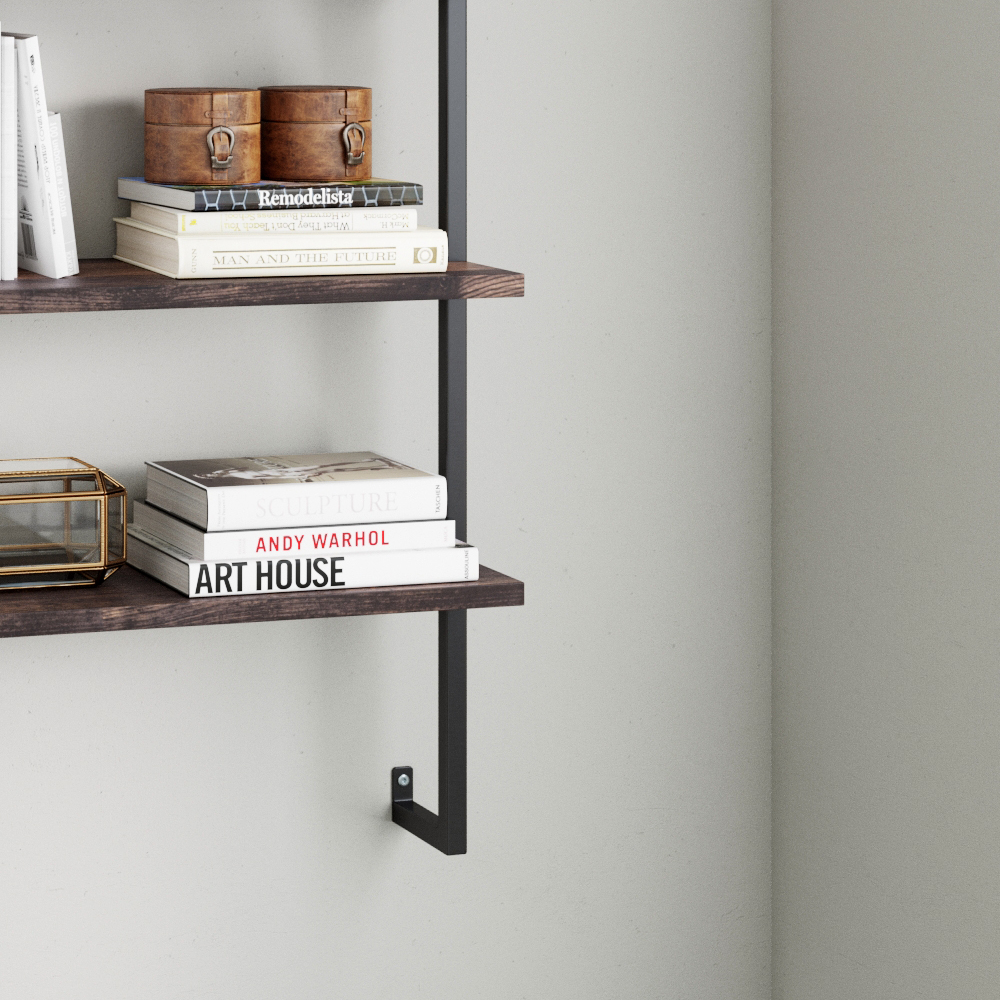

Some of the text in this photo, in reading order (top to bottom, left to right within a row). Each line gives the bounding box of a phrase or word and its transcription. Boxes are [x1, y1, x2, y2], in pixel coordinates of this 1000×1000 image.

[258, 188, 353, 206] Remodelista
[257, 212, 298, 220] Business
[301, 211, 338, 220] Harvard
[363, 212, 409, 220] McCormack
[224, 220, 350, 232] What They Don't Teach You
[389, 221, 409, 229] Mark
[213, 251, 396, 265] MAN AND THE FUTURE
[256, 491, 398, 518] SCULPTURE
[256, 535, 304, 553] ANDY
[312, 530, 389, 549] WARHOL
[195, 556, 346, 595] ART HOUSE
